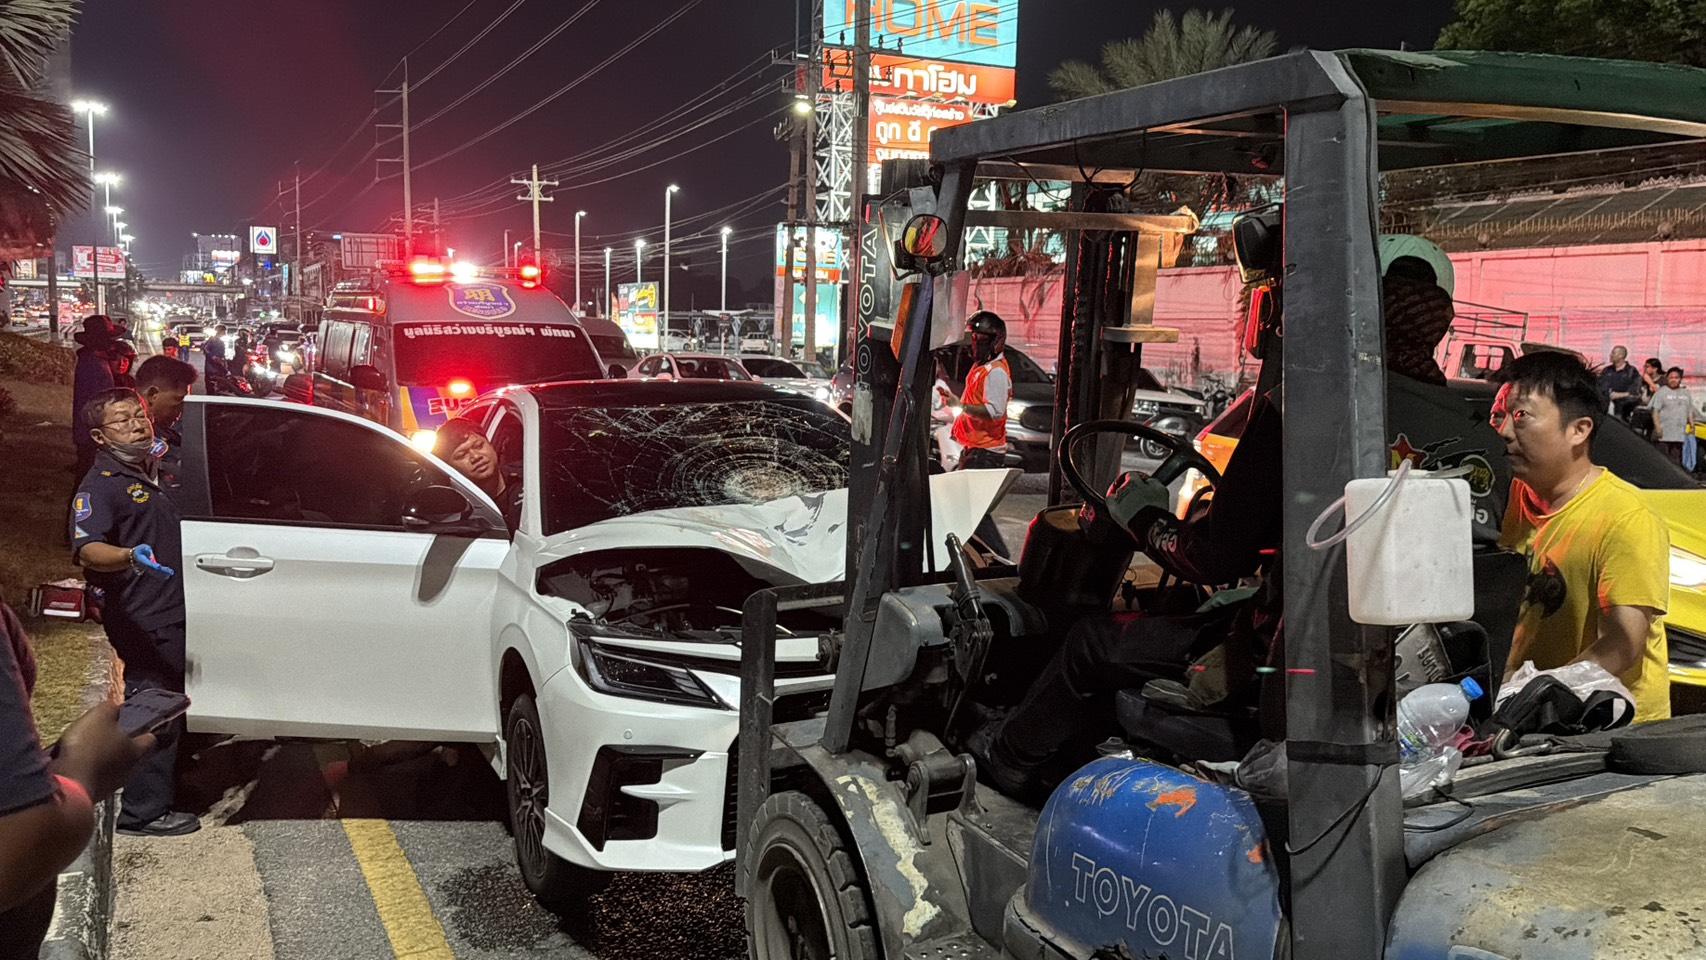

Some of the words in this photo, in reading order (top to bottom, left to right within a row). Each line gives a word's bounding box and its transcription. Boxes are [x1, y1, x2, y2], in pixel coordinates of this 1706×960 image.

[875, 121, 901, 144] ถูก
[907, 119, 922, 142] ดี
[540, 325, 577, 339] พัทยา
[1071, 852, 1235, 960] TOYOTA
